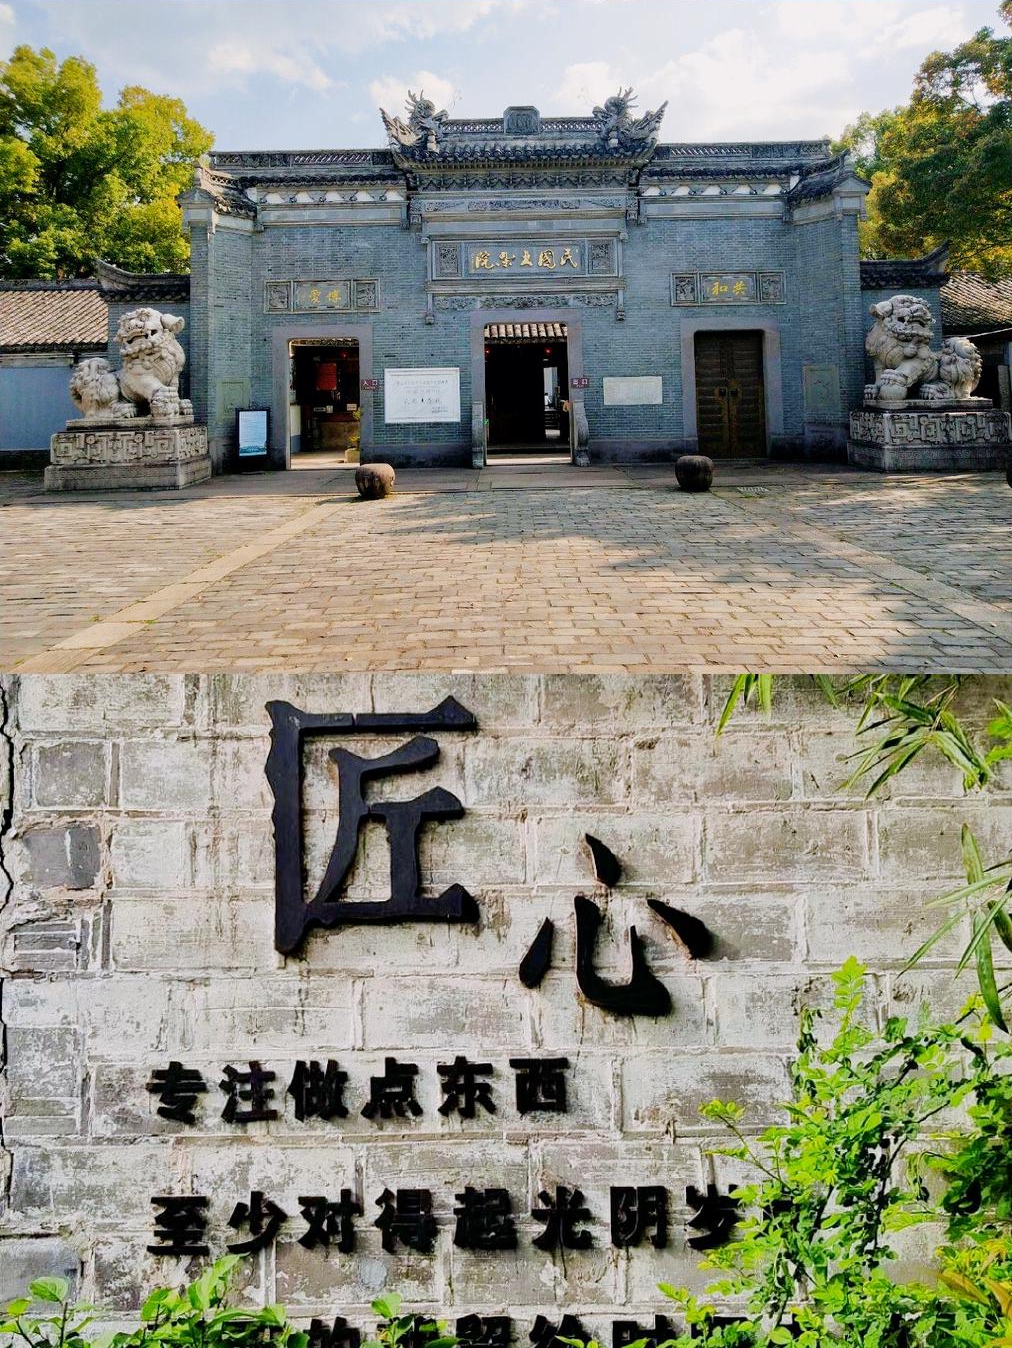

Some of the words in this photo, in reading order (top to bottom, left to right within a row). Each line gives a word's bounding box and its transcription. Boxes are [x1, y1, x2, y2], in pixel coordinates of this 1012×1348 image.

[265, 694, 716, 1016] 匠心
[146, 1056, 568, 1124] 专注做点东西
[147, 1184, 798, 1254] 至少对得起光阴岁
